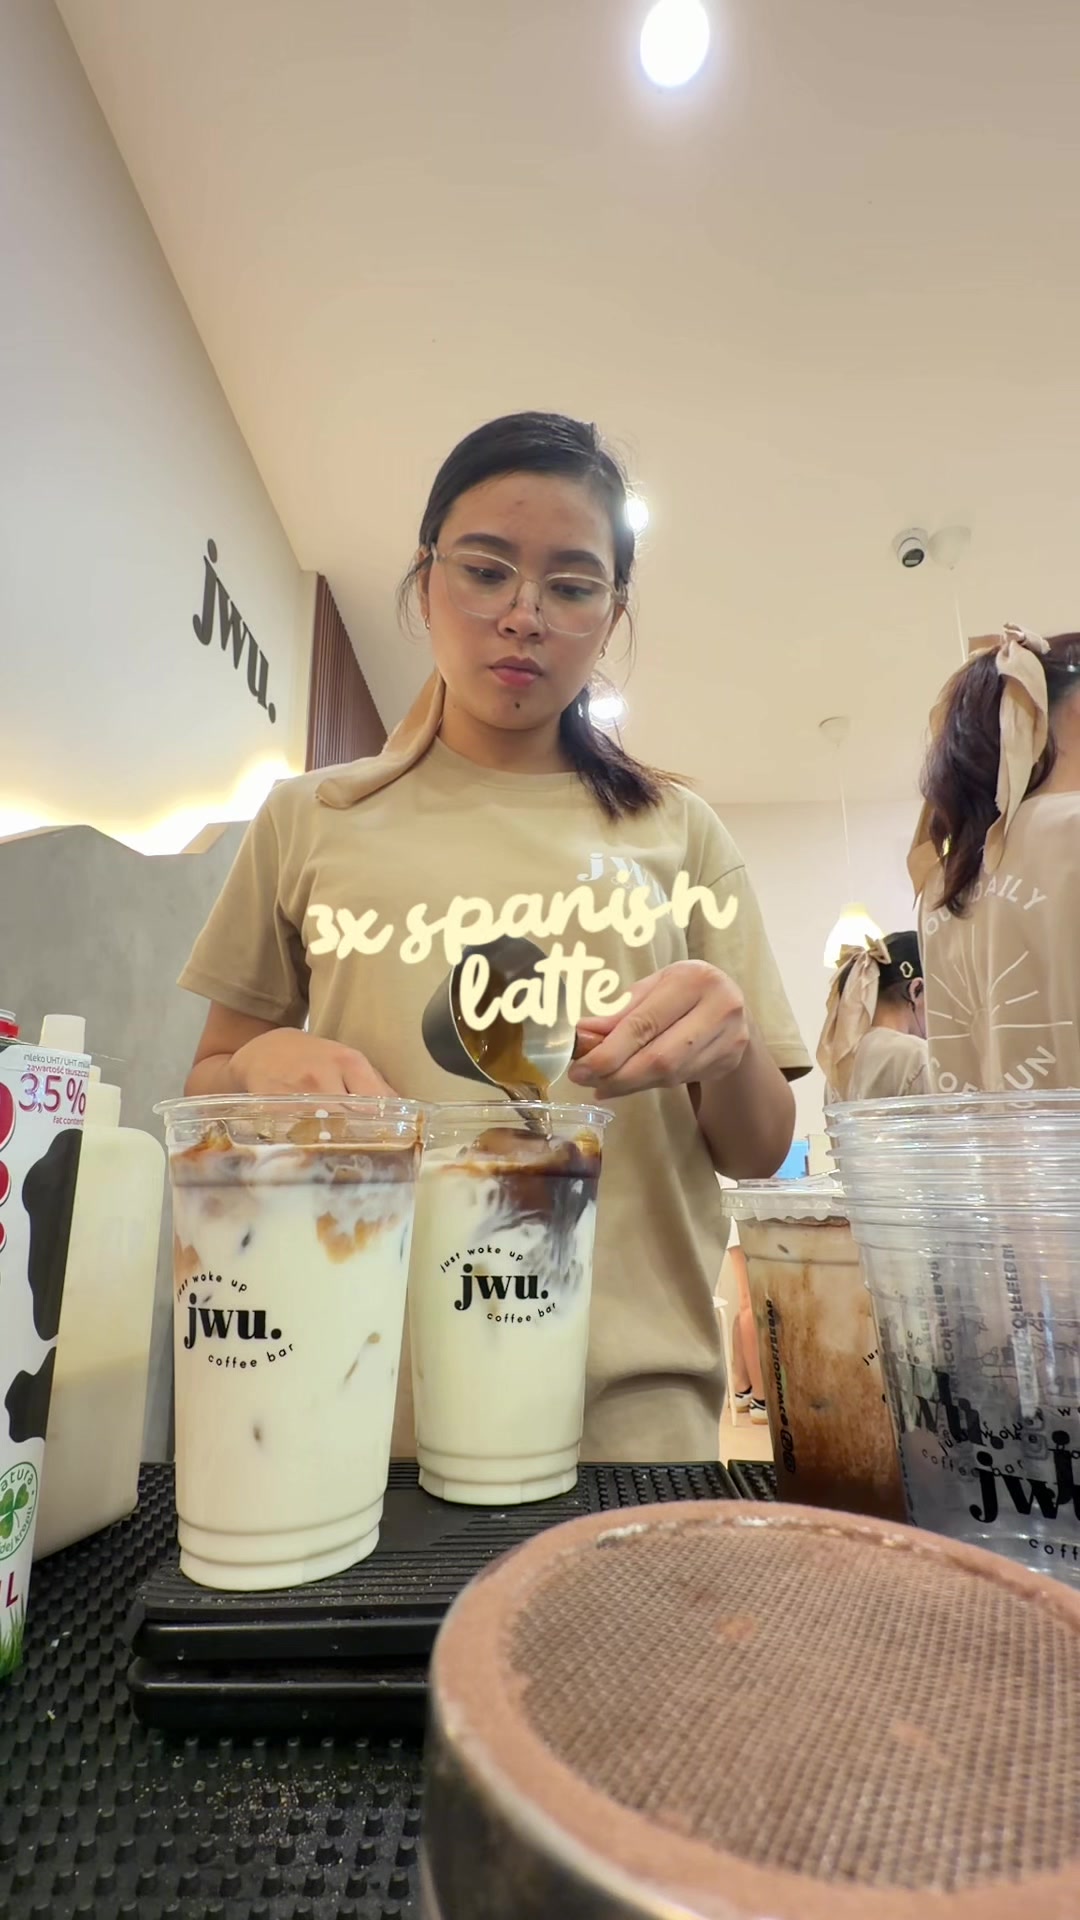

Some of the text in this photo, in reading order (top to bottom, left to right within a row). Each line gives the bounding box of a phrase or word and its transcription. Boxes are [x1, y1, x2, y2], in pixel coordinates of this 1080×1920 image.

[925, 904, 952, 936] OU
[440, 1244, 523, 1273] just woke up
[192, 1270, 222, 1283] woke
[231, 1279, 248, 1293] up
[454, 1263, 548, 1311] jwu.
[183, 1292, 282, 1349] jwu.
[487, 1302, 556, 1323] coffee bar
[208, 1343, 294, 1369] coffee bar
[1, 1468, 34, 1492] atura
[1029, 1538, 1080, 1561] coff
